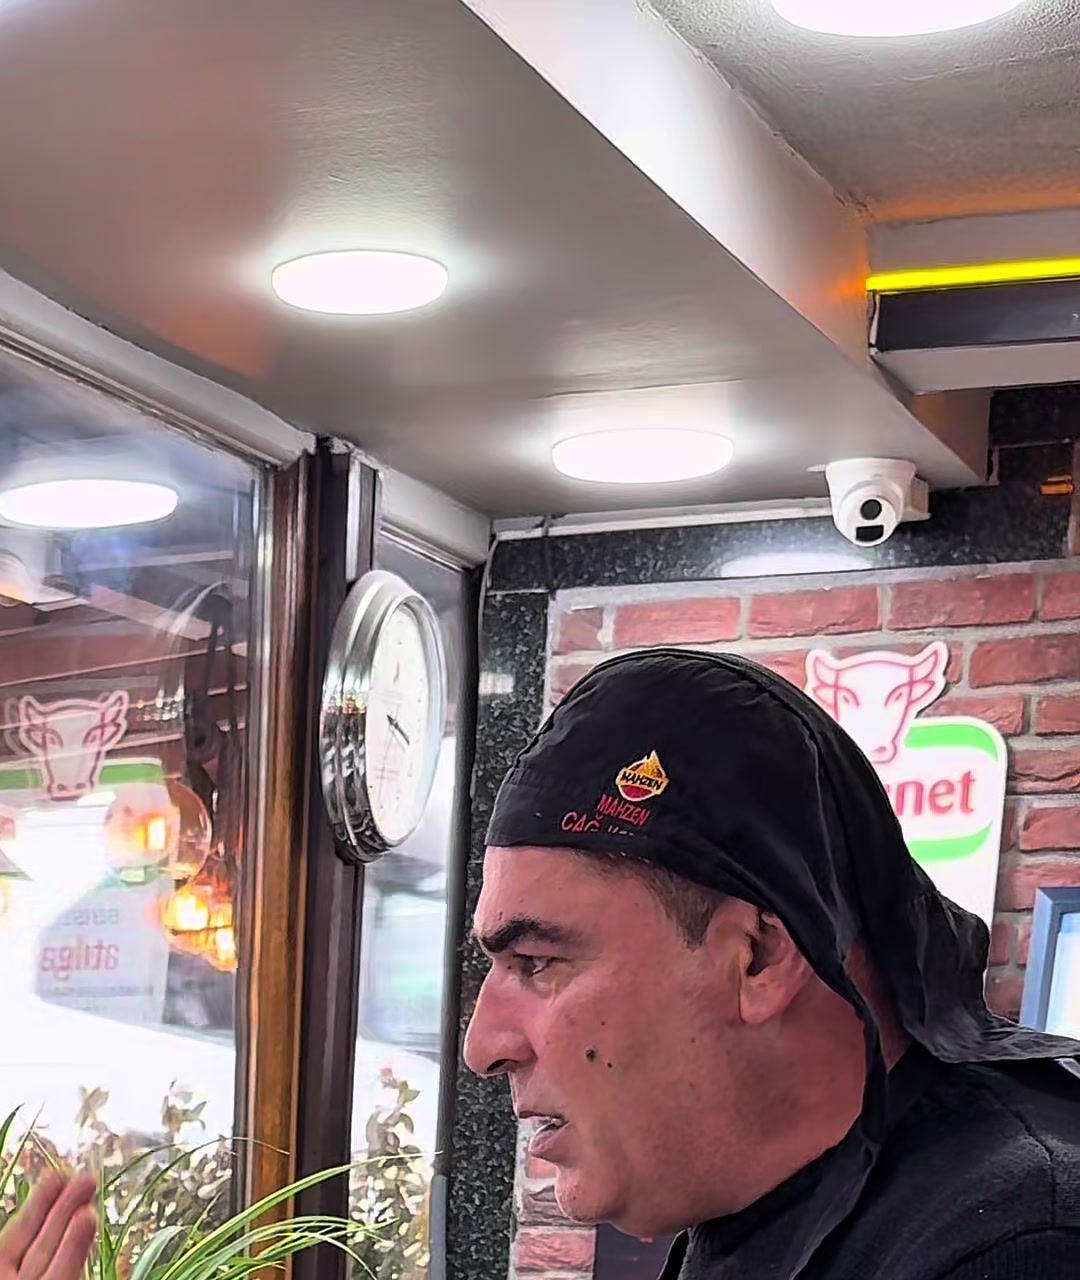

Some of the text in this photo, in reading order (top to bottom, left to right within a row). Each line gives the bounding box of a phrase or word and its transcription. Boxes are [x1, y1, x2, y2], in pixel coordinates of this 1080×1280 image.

[621, 771, 664, 791] MAHZEN
[886, 770, 976, 817] net
[596, 794, 651, 827] MAHZEN
